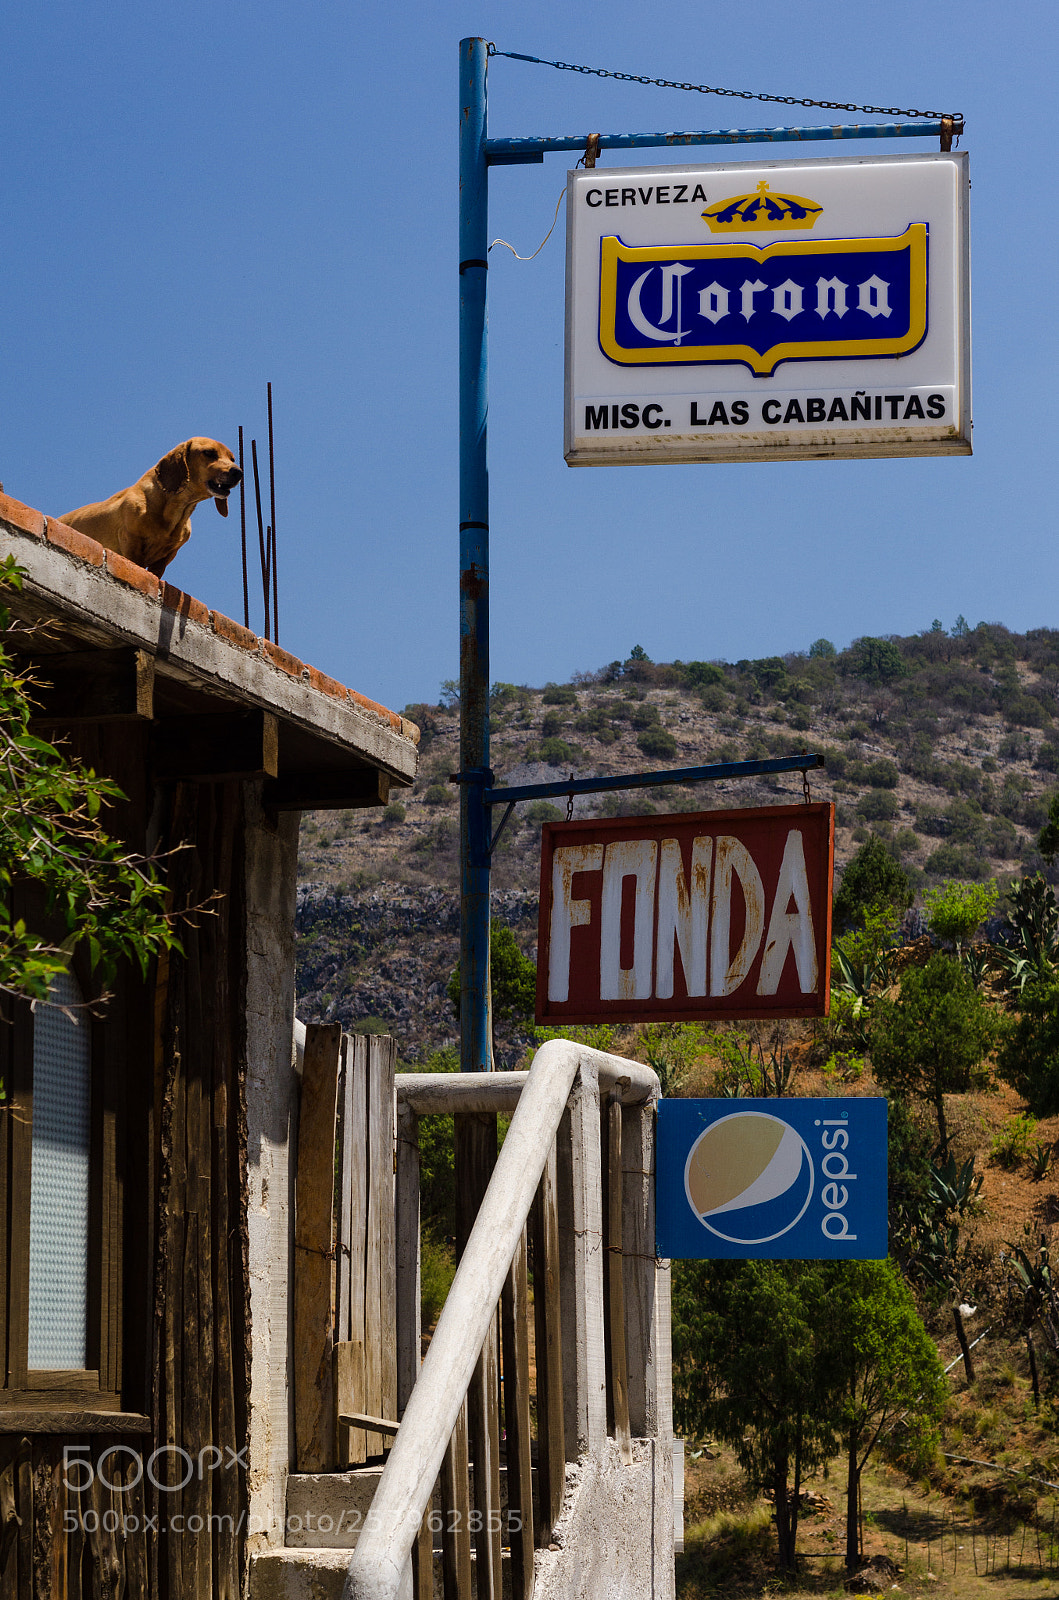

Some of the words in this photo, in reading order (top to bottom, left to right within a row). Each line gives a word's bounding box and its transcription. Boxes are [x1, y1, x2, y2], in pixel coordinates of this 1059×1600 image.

[586, 184, 708, 208] CERVEZA
[627, 262, 894, 346] Corona
[584, 403, 672, 430] MISC.
[690, 400, 750, 426] LAS
[761, 390, 946, 424] CABAÑITAS
[547, 828, 819, 1003] FONDA
[814, 1119, 857, 1241] pepsi
